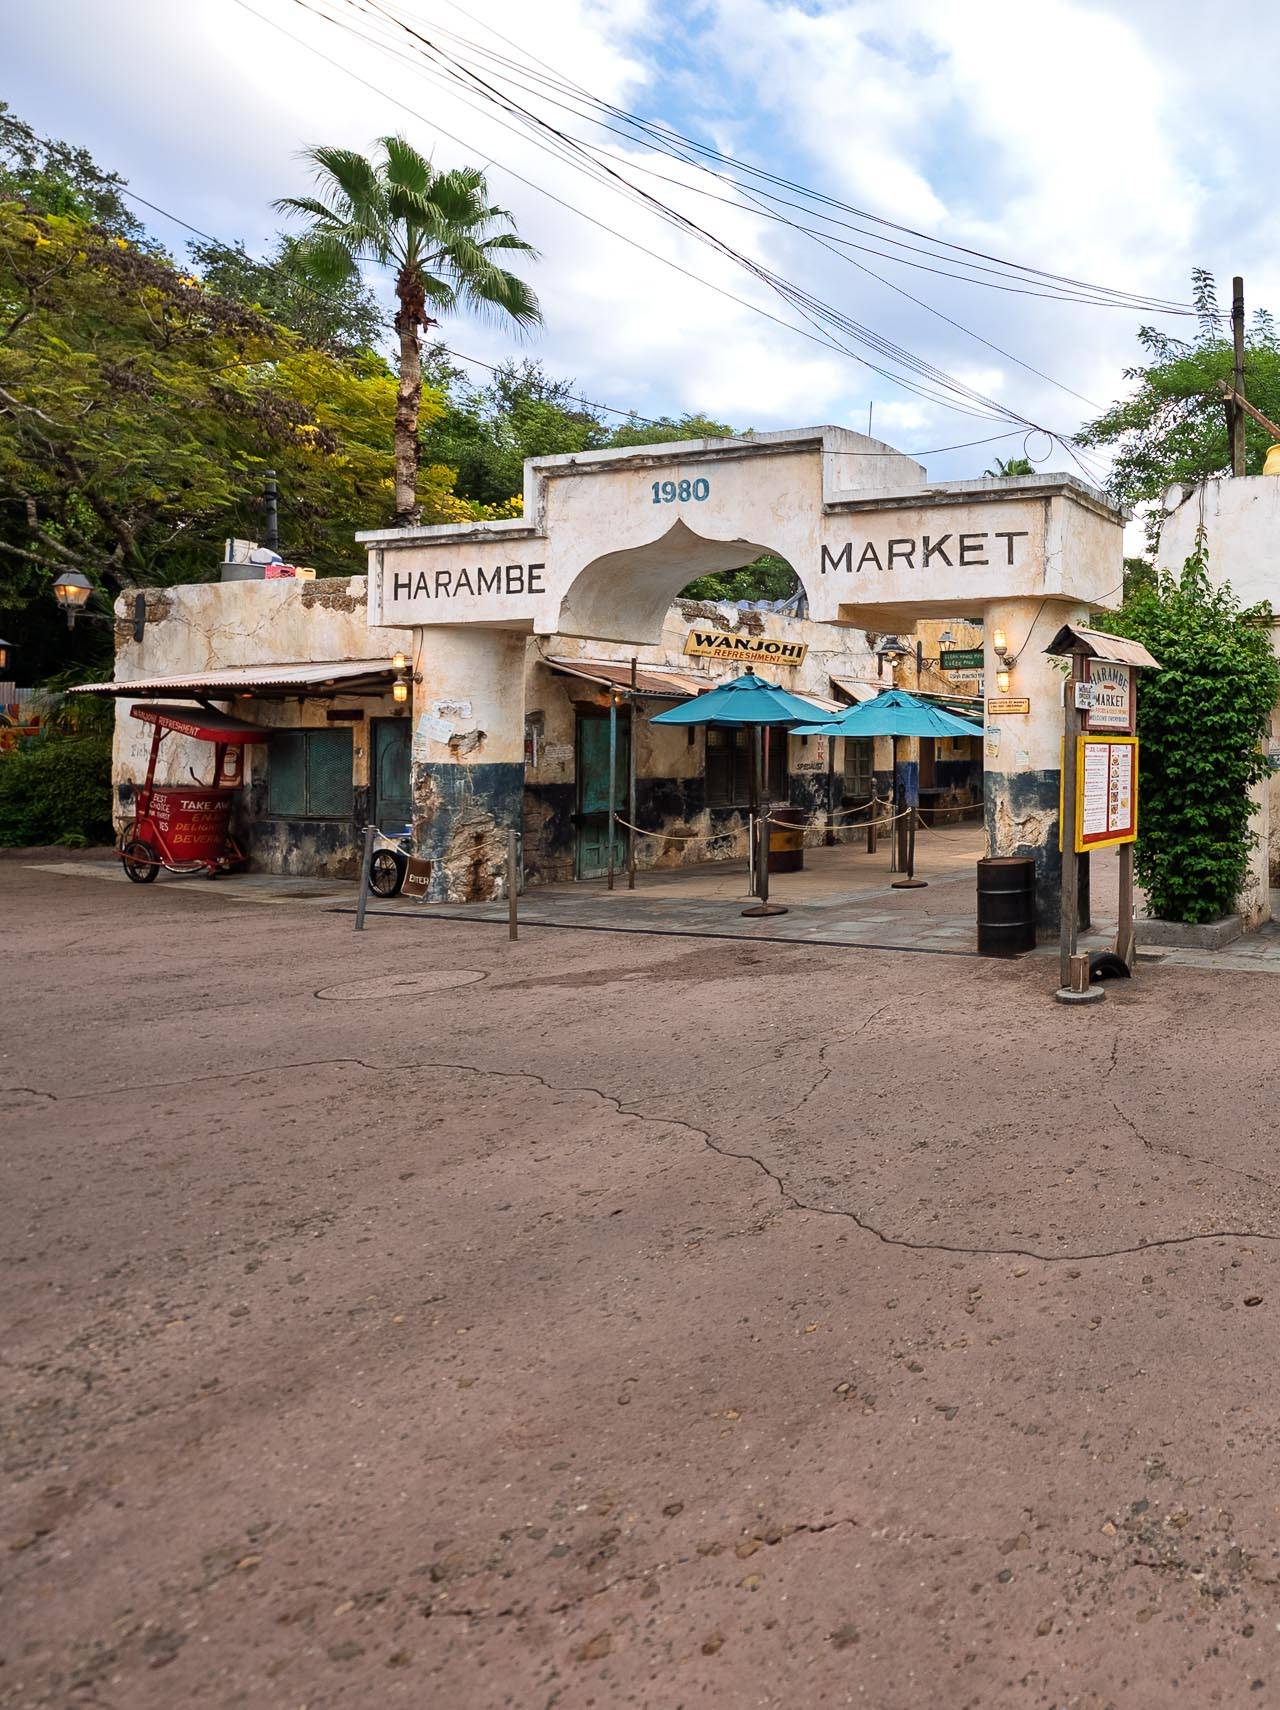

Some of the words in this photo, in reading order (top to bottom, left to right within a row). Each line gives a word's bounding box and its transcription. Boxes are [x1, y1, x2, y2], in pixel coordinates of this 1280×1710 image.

[650, 477, 711, 504] 1980
[821, 531, 1029, 574] MARKET
[393, 562, 546, 601] HARAMBE
[694, 633, 804, 659] WANJOHI
[713, 648, 781, 663] REFRESHMENT
[1089, 666, 1129, 694] HARAMBE
[1095, 693, 1125, 708] MARKET
[149, 801, 171, 813] CHOICE
[153, 793, 168, 802] BEST
[180, 800, 211, 810] TAKE
